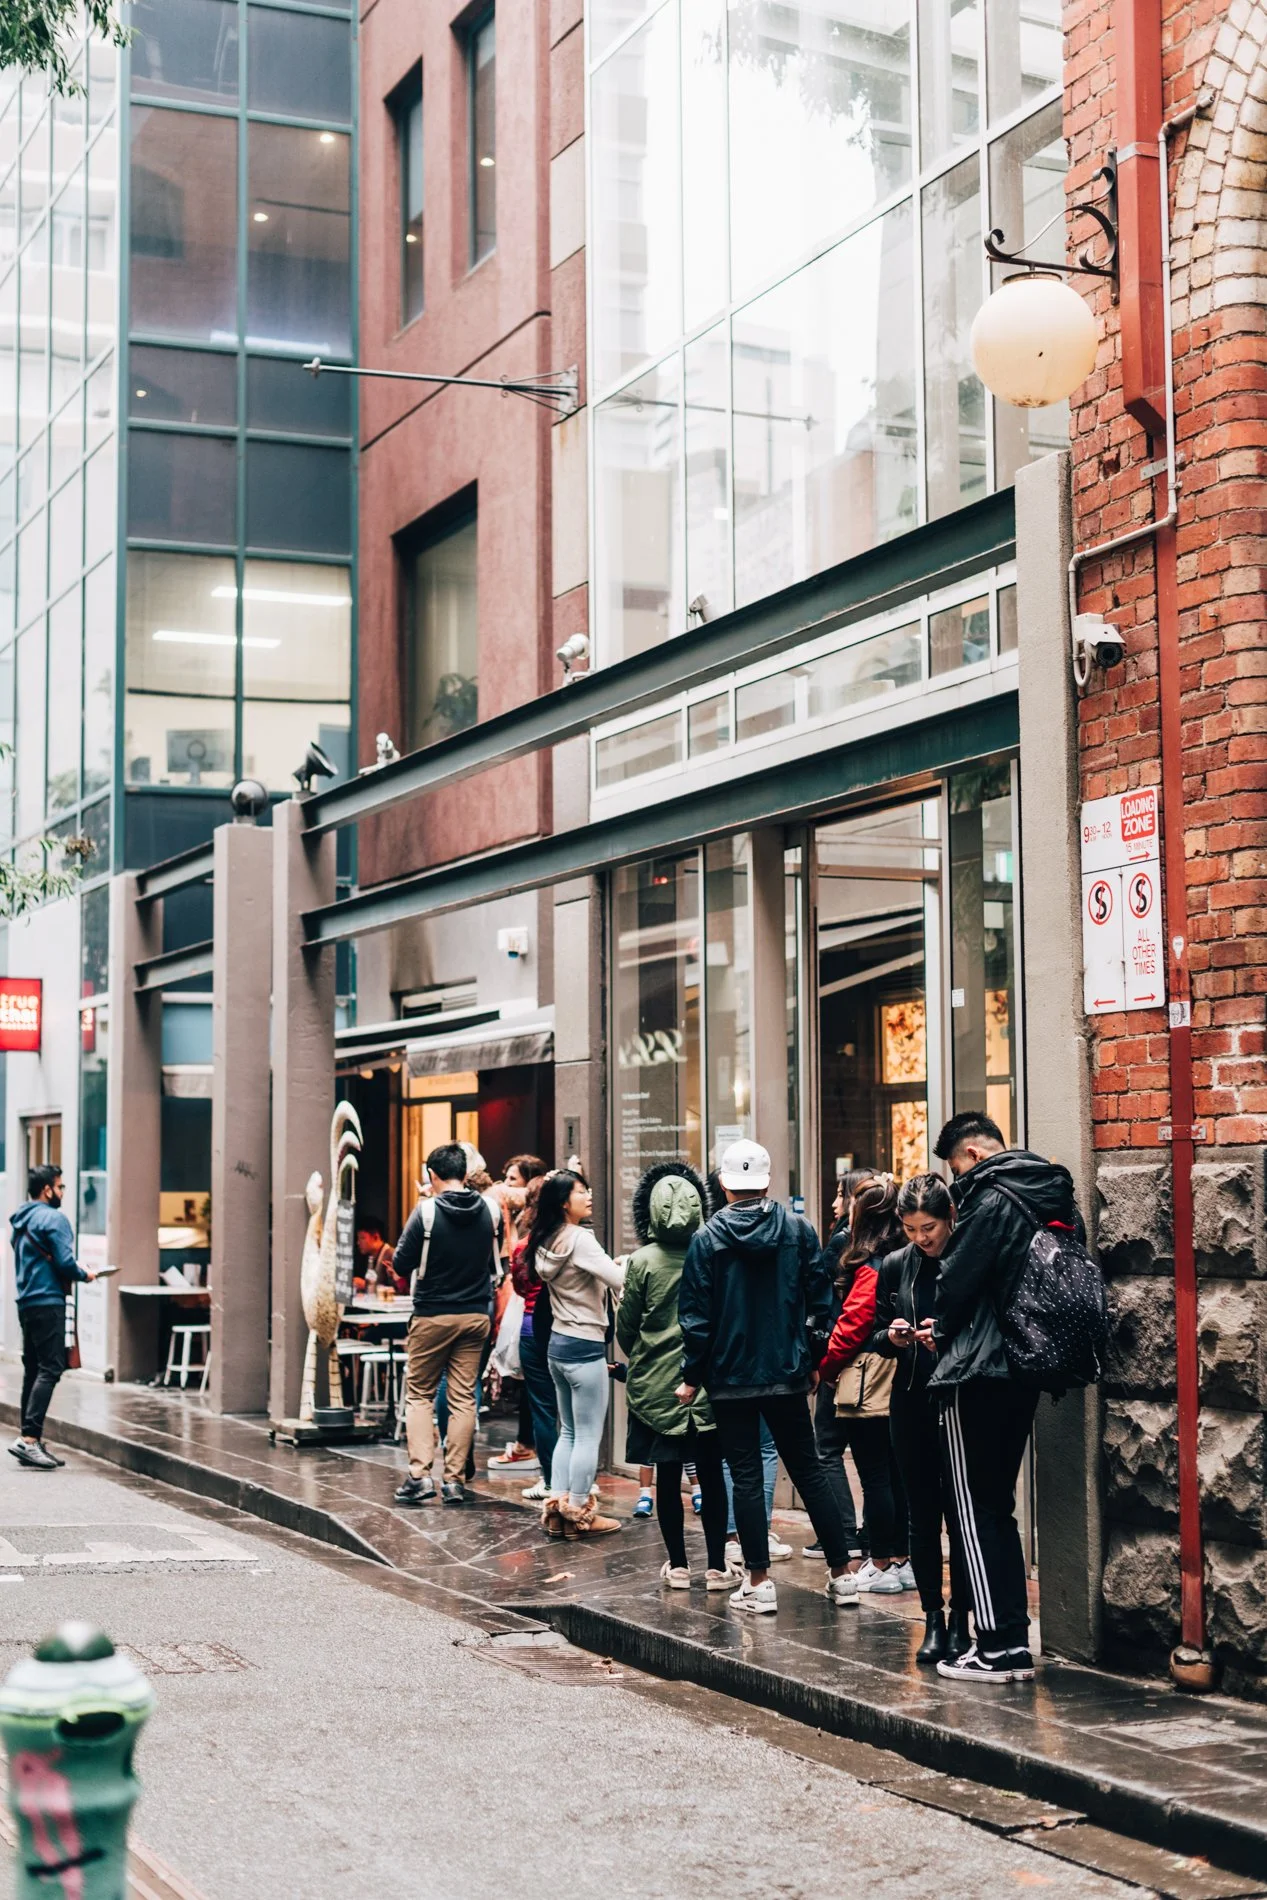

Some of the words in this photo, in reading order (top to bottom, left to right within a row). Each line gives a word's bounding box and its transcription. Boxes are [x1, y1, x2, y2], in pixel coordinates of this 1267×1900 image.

[1121, 795, 1154, 819] LOADING
[1123, 813, 1153, 836] ZONE
[1137, 928, 1150, 942] ALL
[1132, 943, 1156, 960] OTHER
[1134, 960, 1156, 976] TIMES
